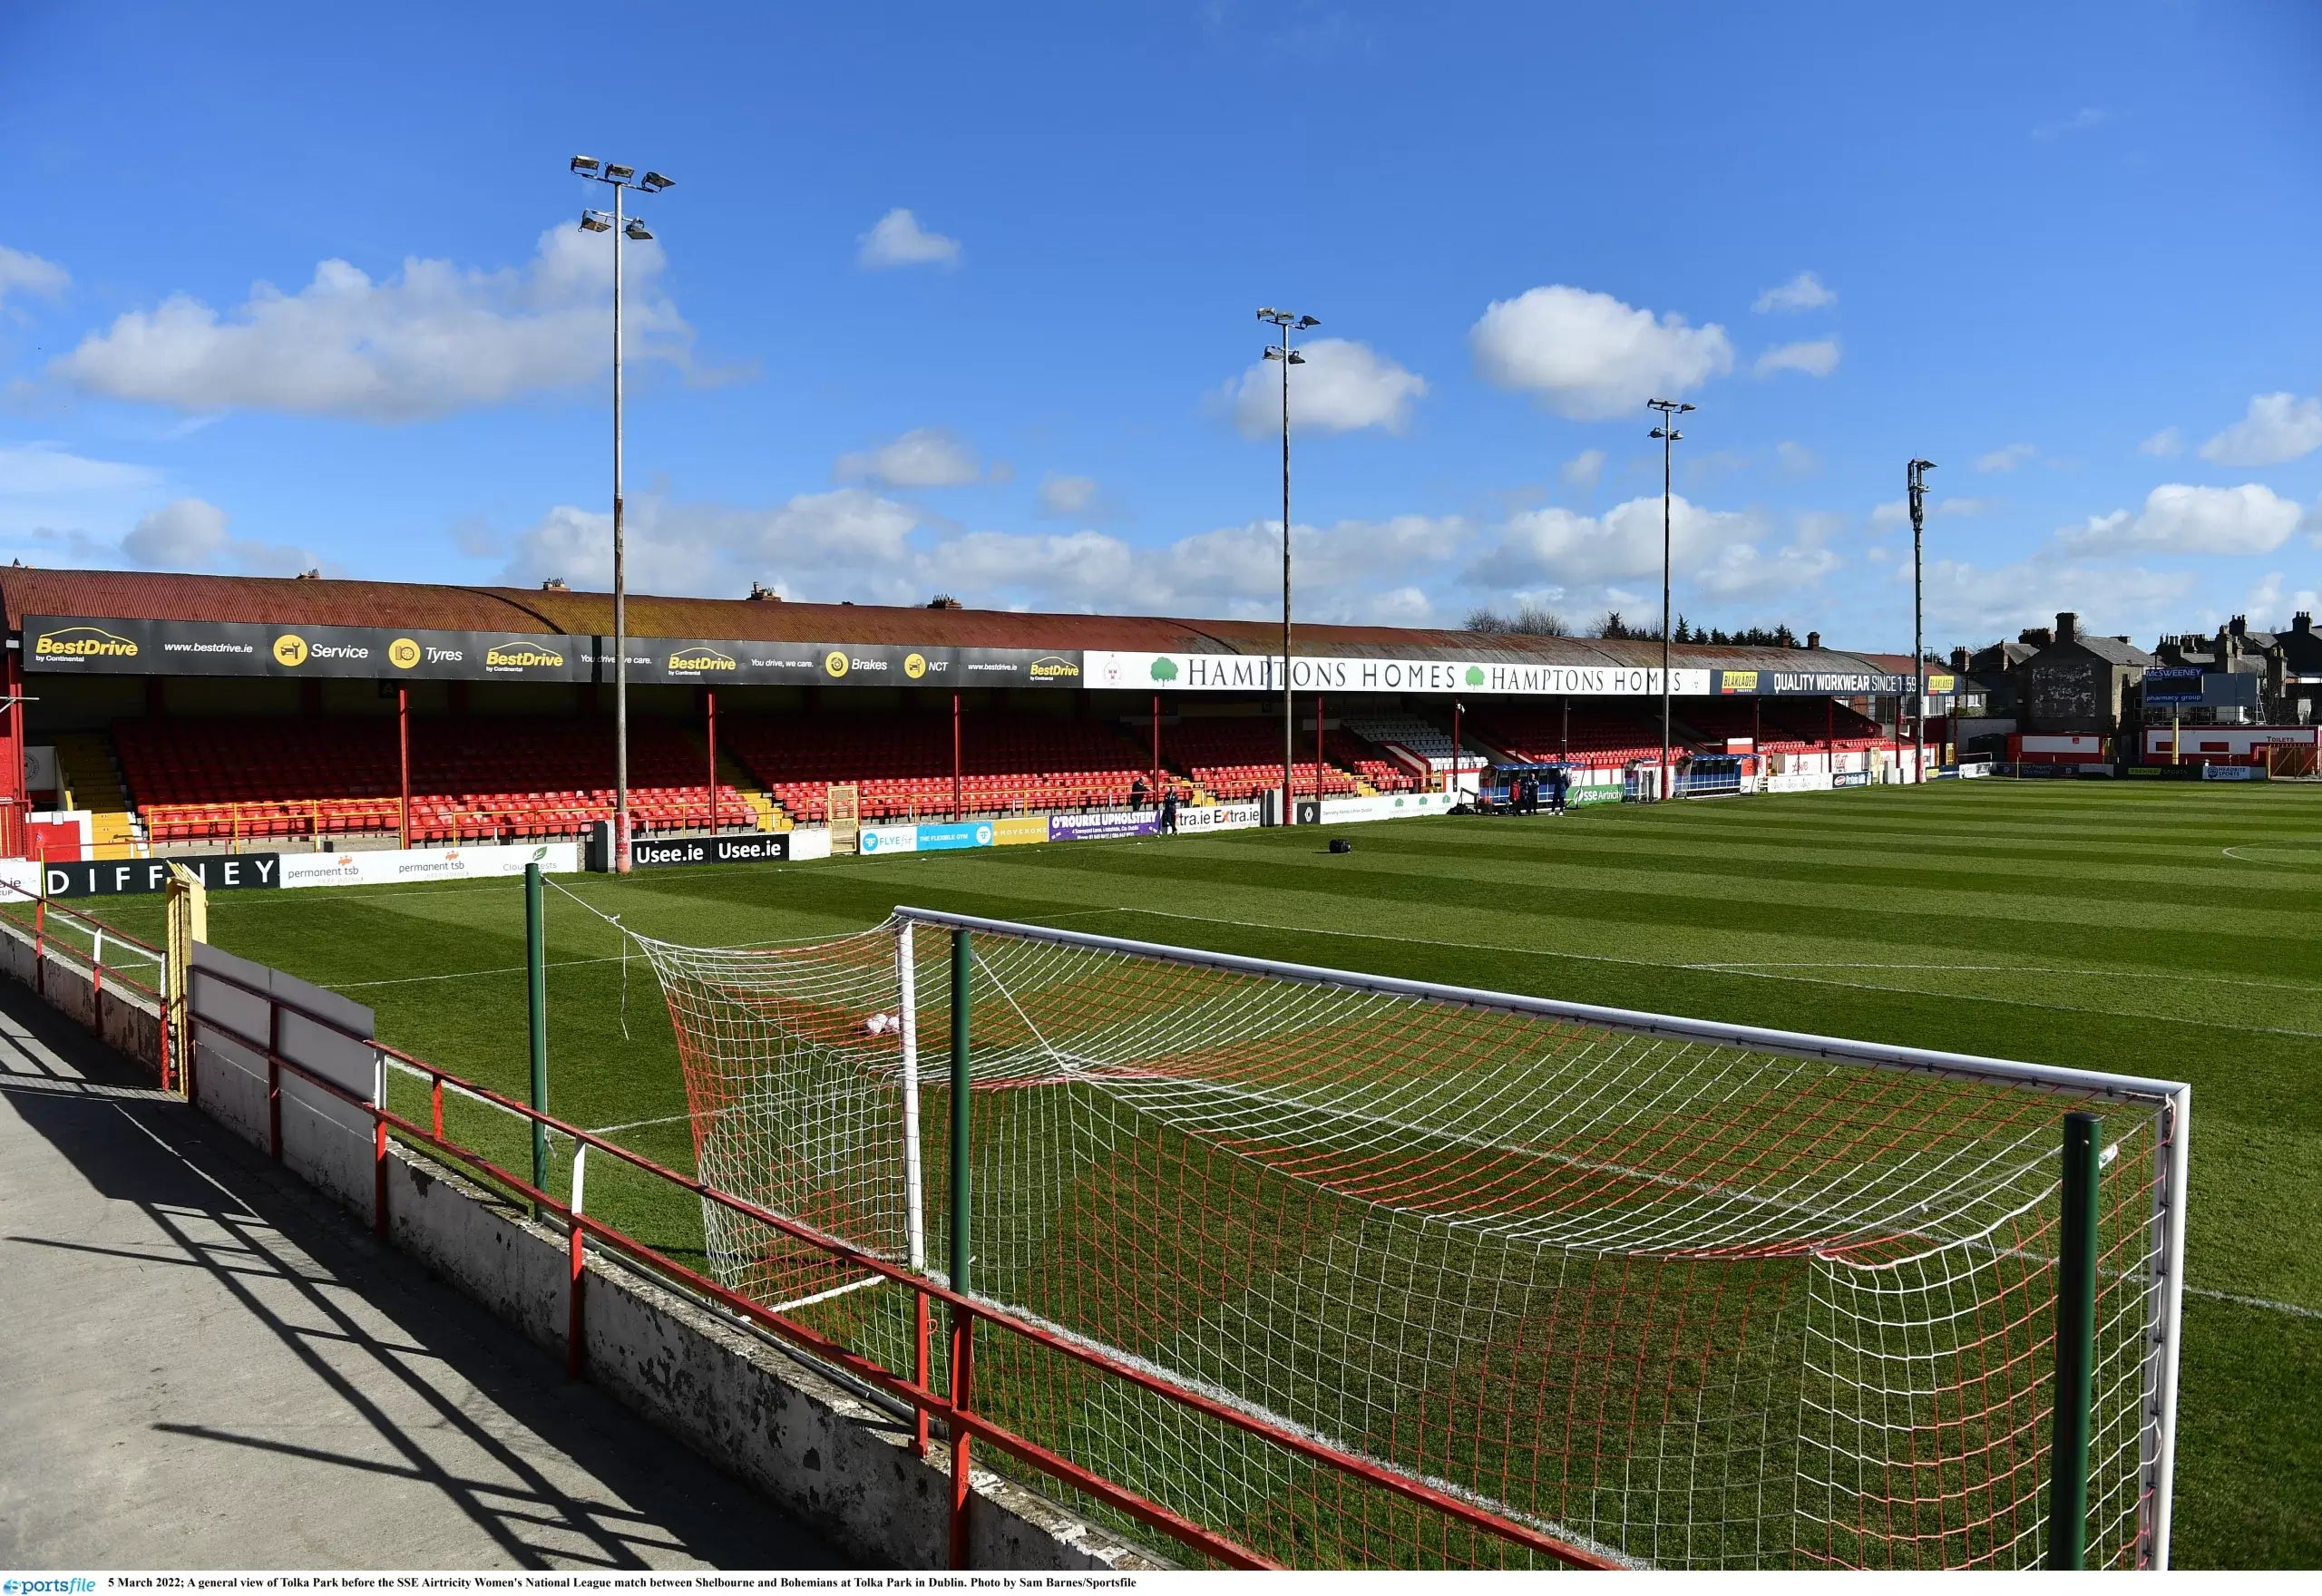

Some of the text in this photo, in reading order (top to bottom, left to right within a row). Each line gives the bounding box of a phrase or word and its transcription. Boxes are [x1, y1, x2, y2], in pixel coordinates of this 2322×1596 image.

[35, 637, 139, 657] BestDrive
[164, 642, 253, 654] www.bestdrive.ie
[310, 644, 369, 658] Service
[425, 647, 463, 662] Tyres
[486, 651, 564, 667] BestDrive
[633, 657, 653, 665] care.
[668, 657, 737, 671] BestDrive
[751, 658, 765, 667] You
[766, 658, 784, 668] drive,
[794, 660, 814, 668] care.
[852, 658, 888, 671] Brakes
[928, 661, 948, 672] NCT
[967, 662, 1018, 672] www.bestdrive.ie
[1030, 664, 1079, 676] BestDrive
[1187, 658, 1456, 688] HAMPTONS HOMES
[1491, 667, 1681, 691] HAMPTONS HOMS
[2146, 668, 2202, 677] McSWEENEY
[1773, 673, 1814, 694] QUALITY
[1816, 674, 1870, 691] WORKWEAR
[1871, 675, 1897, 692] SINCE
[2181, 694, 2201, 702] group
[1584, 790, 1598, 801] sse
[1052, 811, 1158, 829] O'ROURKE UPHOLSTERY
[1214, 807, 1260, 823] Extra.ie
[919, 834, 931, 842] THE
[931, 833, 955, 842] FLEXIBLE
[636, 844, 704, 864] Usee.ie
[718, 840, 781, 860] Usee.ie
[288, 865, 359, 879] permanent tsb
[399, 860, 464, 873] permanent tsb
